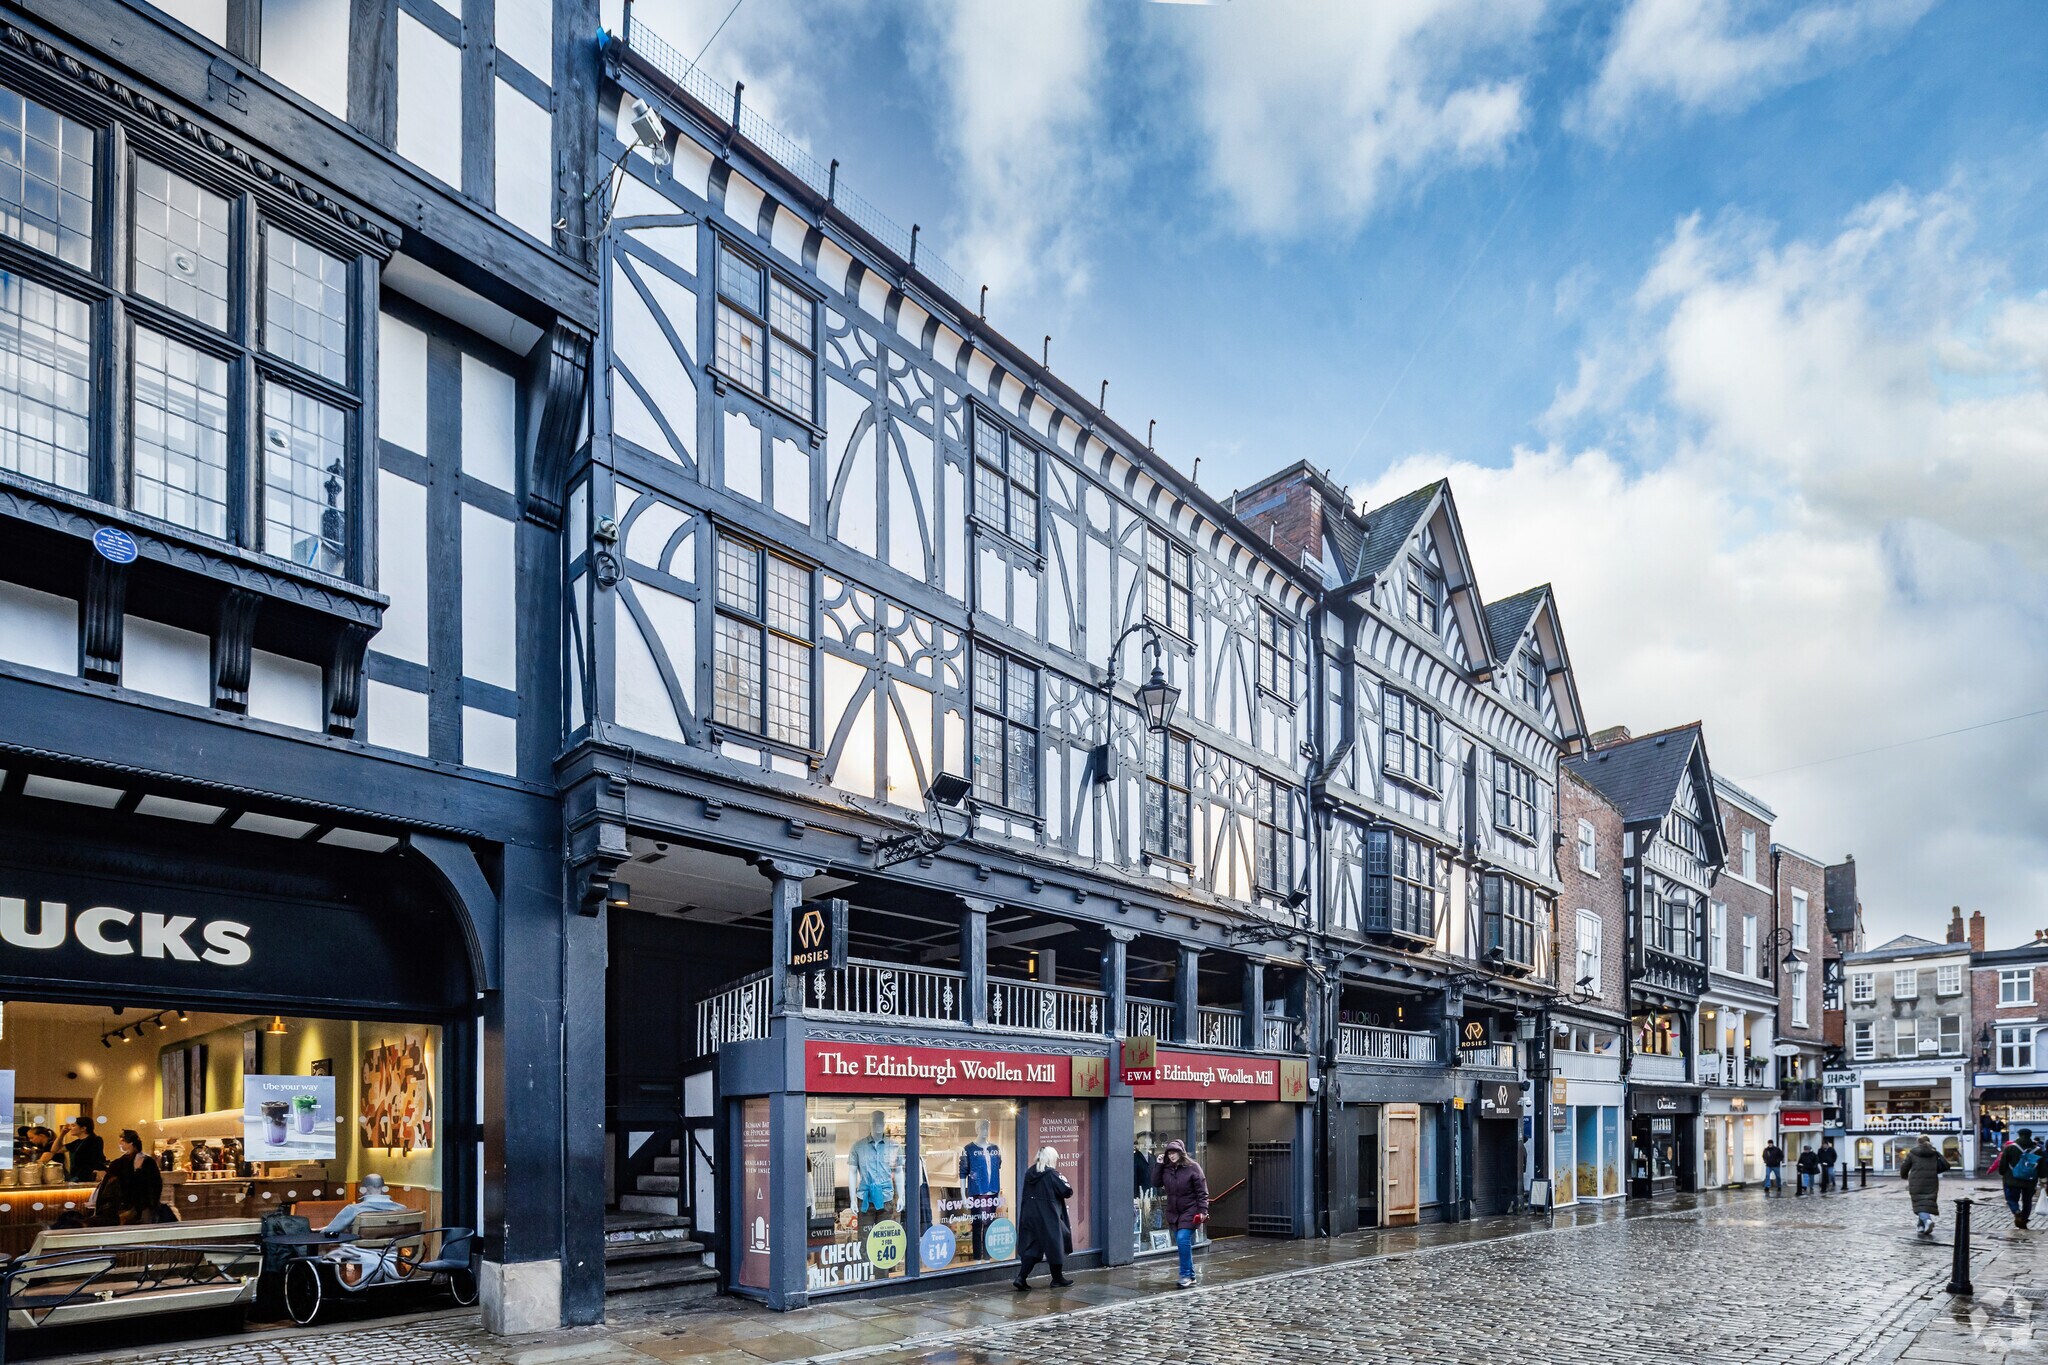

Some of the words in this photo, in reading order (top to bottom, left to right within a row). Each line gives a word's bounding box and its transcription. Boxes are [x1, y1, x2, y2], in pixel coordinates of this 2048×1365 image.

[793, 950, 829, 965] ROSIES
[818, 1052, 858, 1075] The
[864, 1055, 957, 1085] Edinburgh
[960, 1060, 1023, 1082] Woollen
[1026, 1063, 1056, 1083] Mill
[1127, 1071, 1152, 1081] EWM
[1163, 1065, 1216, 1087] Edinburgh
[1217, 1067, 1254, 1084] Woollen
[1255, 1070, 1273, 1085] Mill
[1827, 1073, 1857, 1084] SHRUB
[281, 1084, 299, 1092] your
[301, 1084, 319, 1092] way
[745, 1121, 761, 1129] ROMAN
[1042, 1117, 1063, 1125] ROMAN
[1064, 1117, 1077, 1125] BATH
[810, 1126, 827, 1138] £40
[937, 1198, 963, 1212] New
[965, 1196, 1006, 1210] Season
[873, 1229, 901, 1239] MENSWEAR
[988, 1232, 1014, 1247] OFFERS
[820, 1241, 862, 1265] CHECK
[877, 1245, 897, 1262] £40
[928, 1242, 948, 1260] £14
[843, 1261, 876, 1284] OUT!
